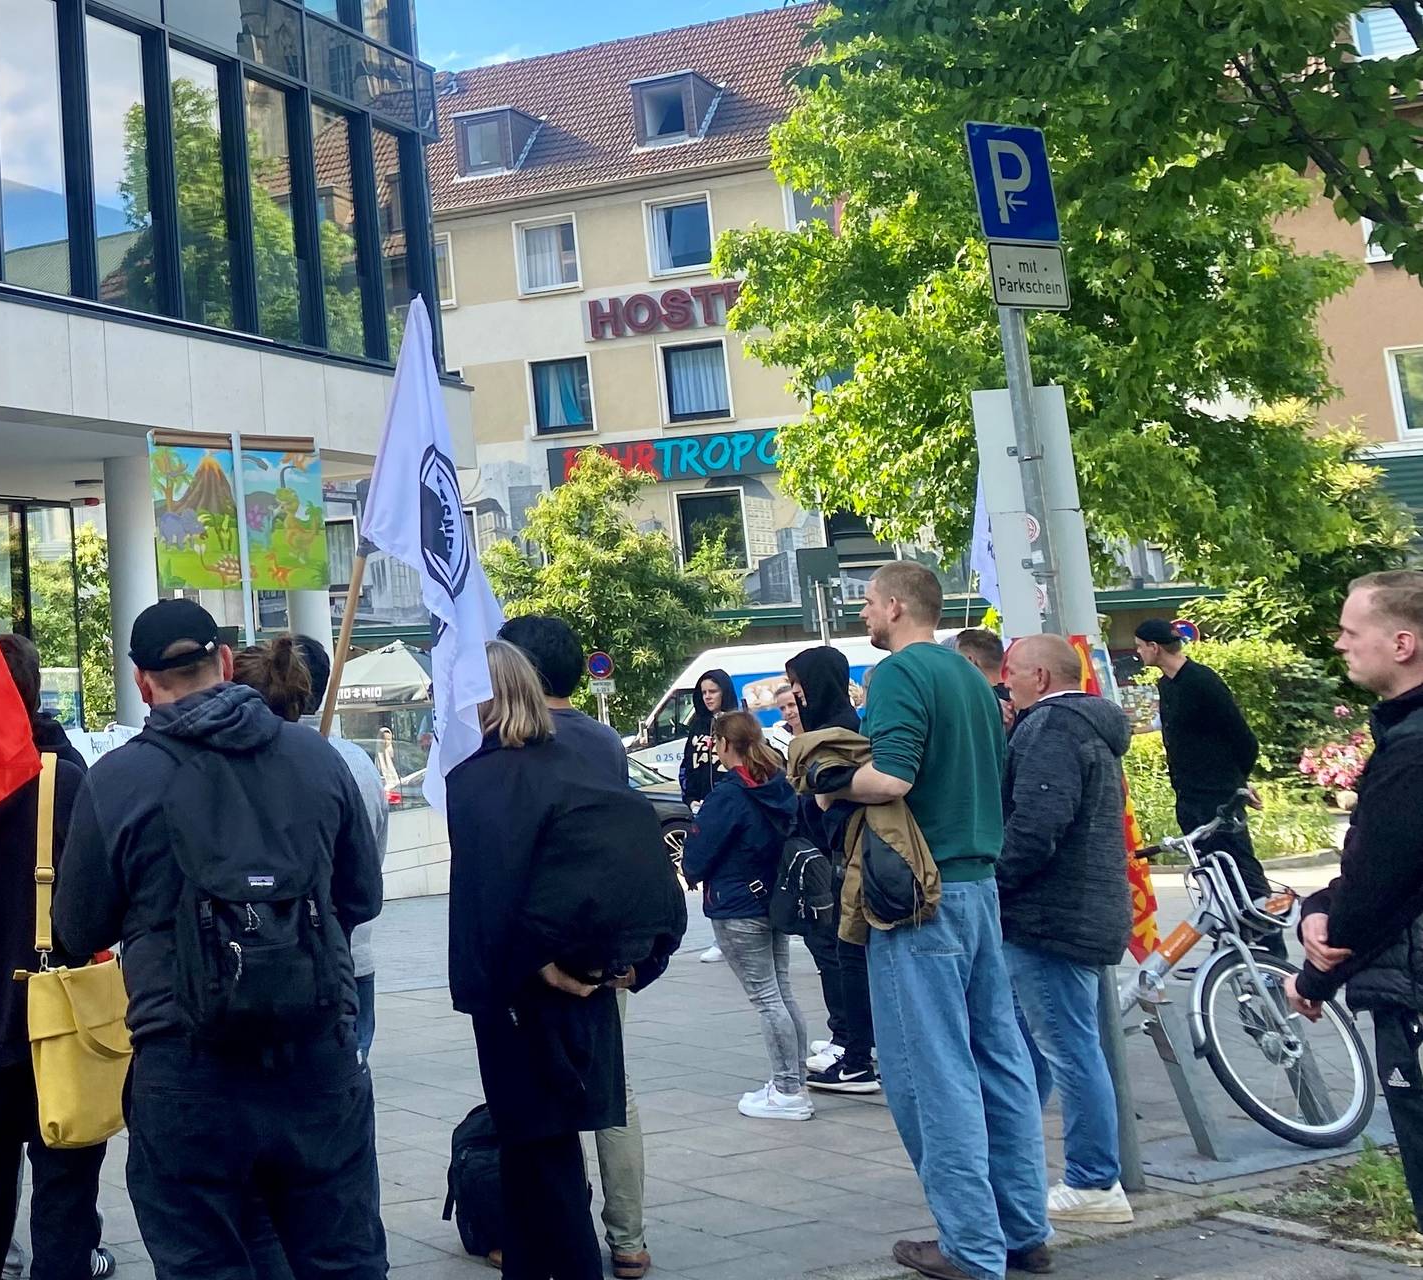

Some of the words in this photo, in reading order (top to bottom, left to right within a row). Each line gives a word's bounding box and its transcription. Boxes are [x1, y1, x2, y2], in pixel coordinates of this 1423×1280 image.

[987, 139, 1032, 224] P
[1018, 259, 1038, 274] mit
[998, 276, 1063, 295] Parkschein
[361, 687, 383, 699] MIO
[664, 753, 674, 761] 25
